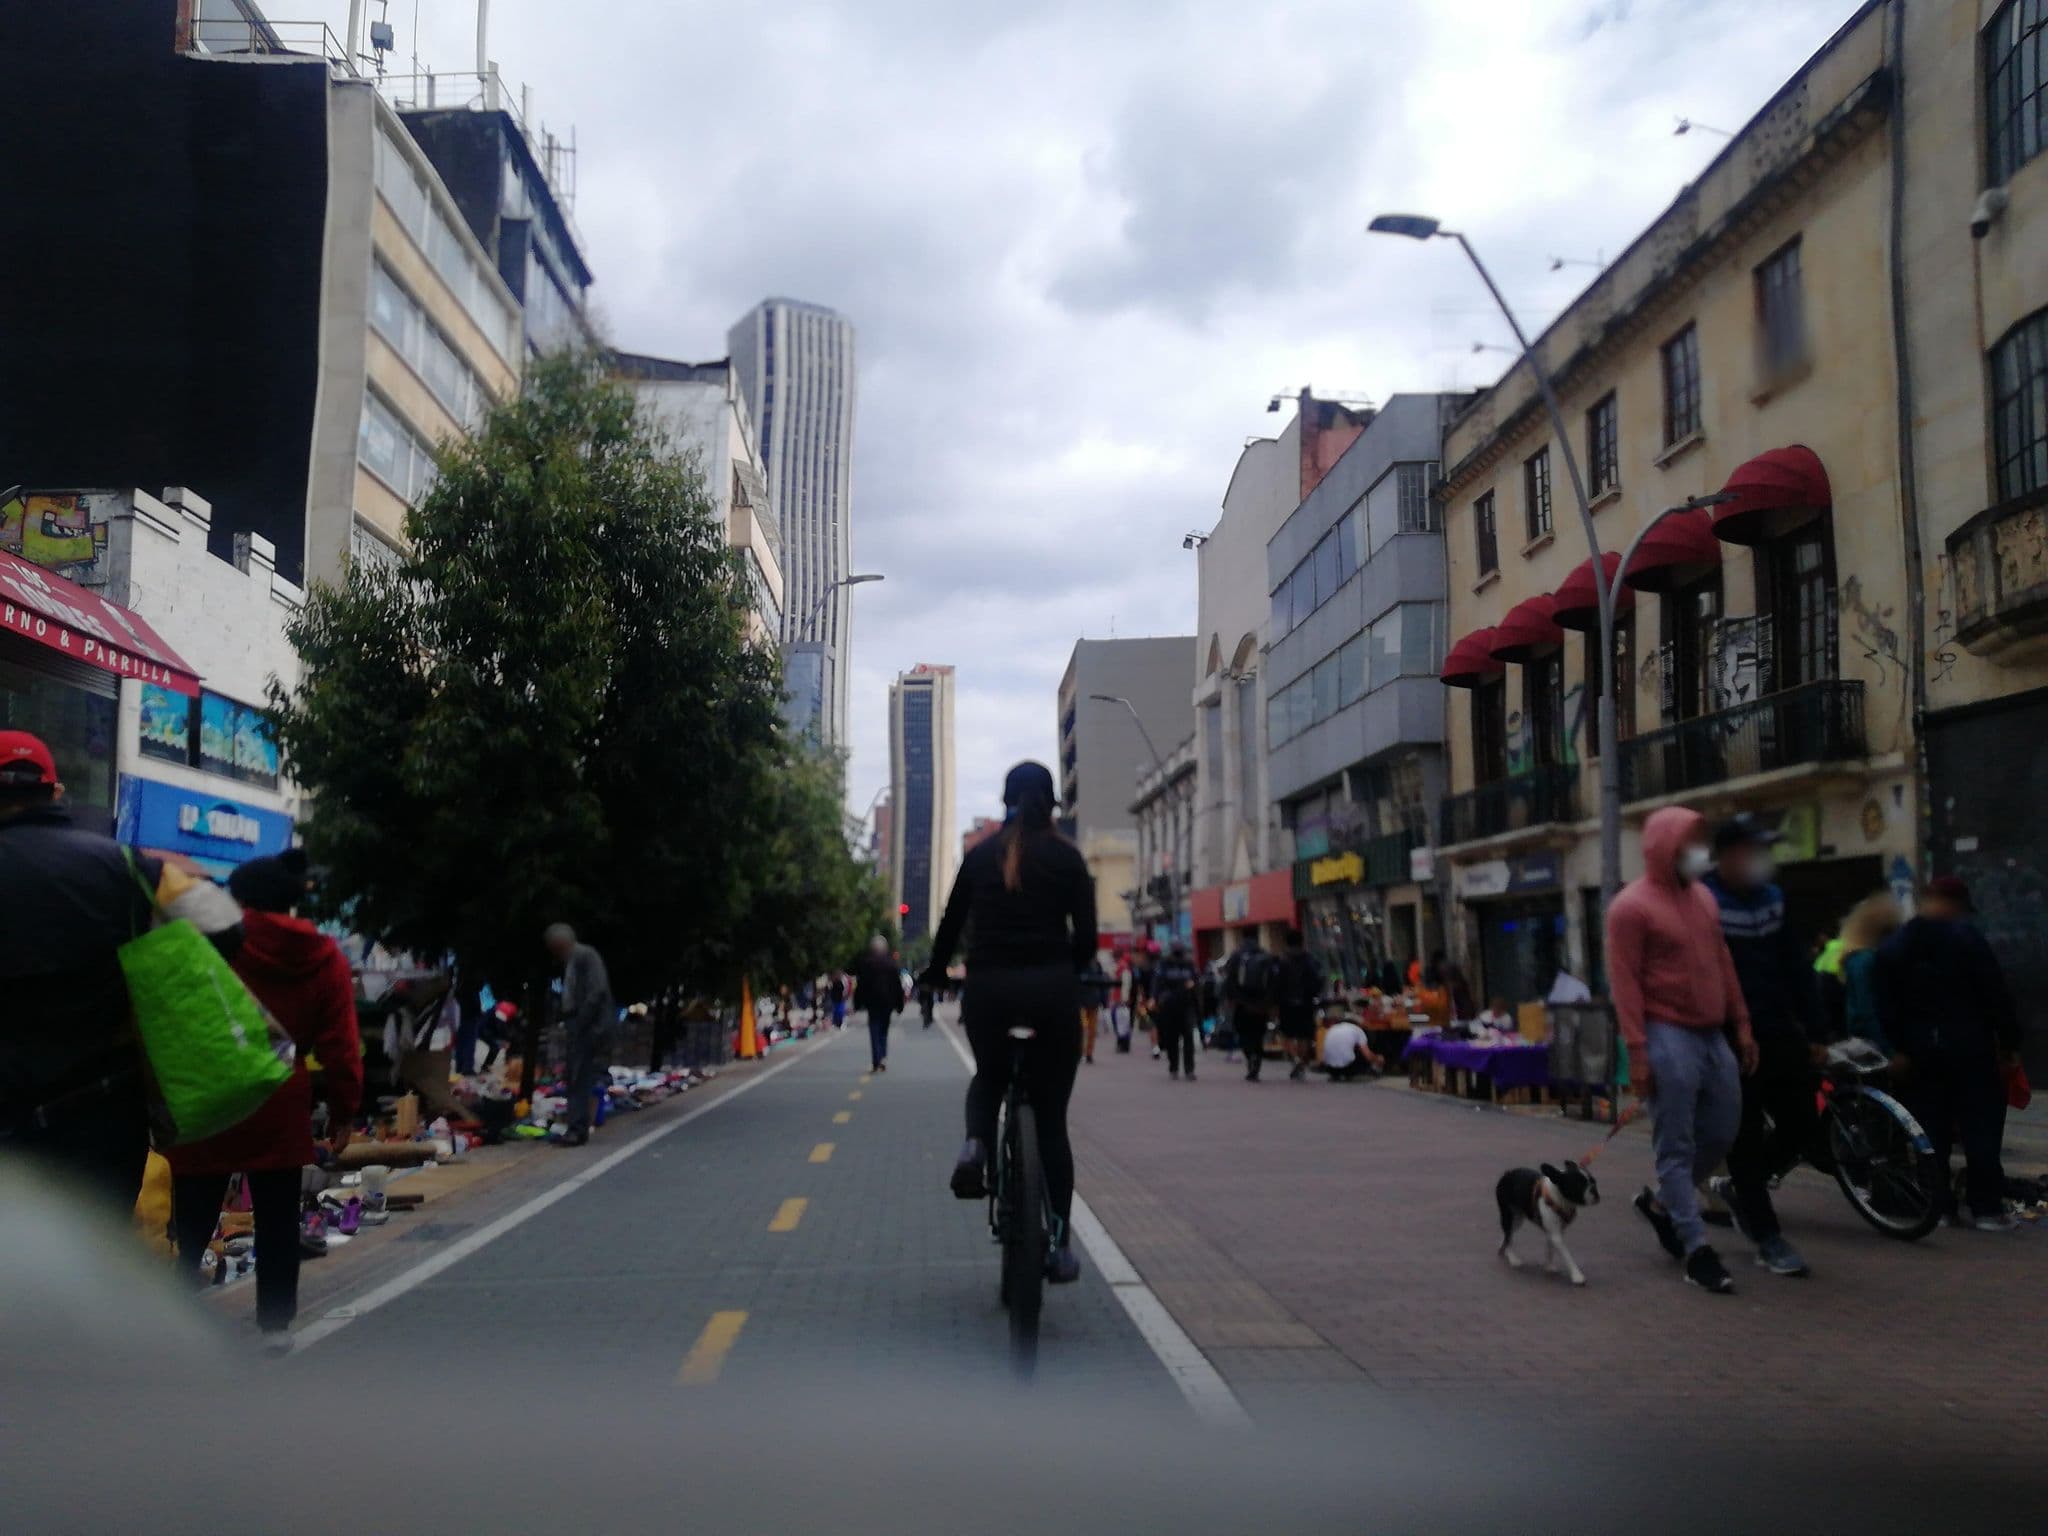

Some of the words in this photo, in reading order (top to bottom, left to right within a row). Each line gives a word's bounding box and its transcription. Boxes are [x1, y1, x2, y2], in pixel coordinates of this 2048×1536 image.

[5, 603, 46, 636] RNO
[60, 629, 70, 647] &
[84, 639, 171, 684] PARRILLA
